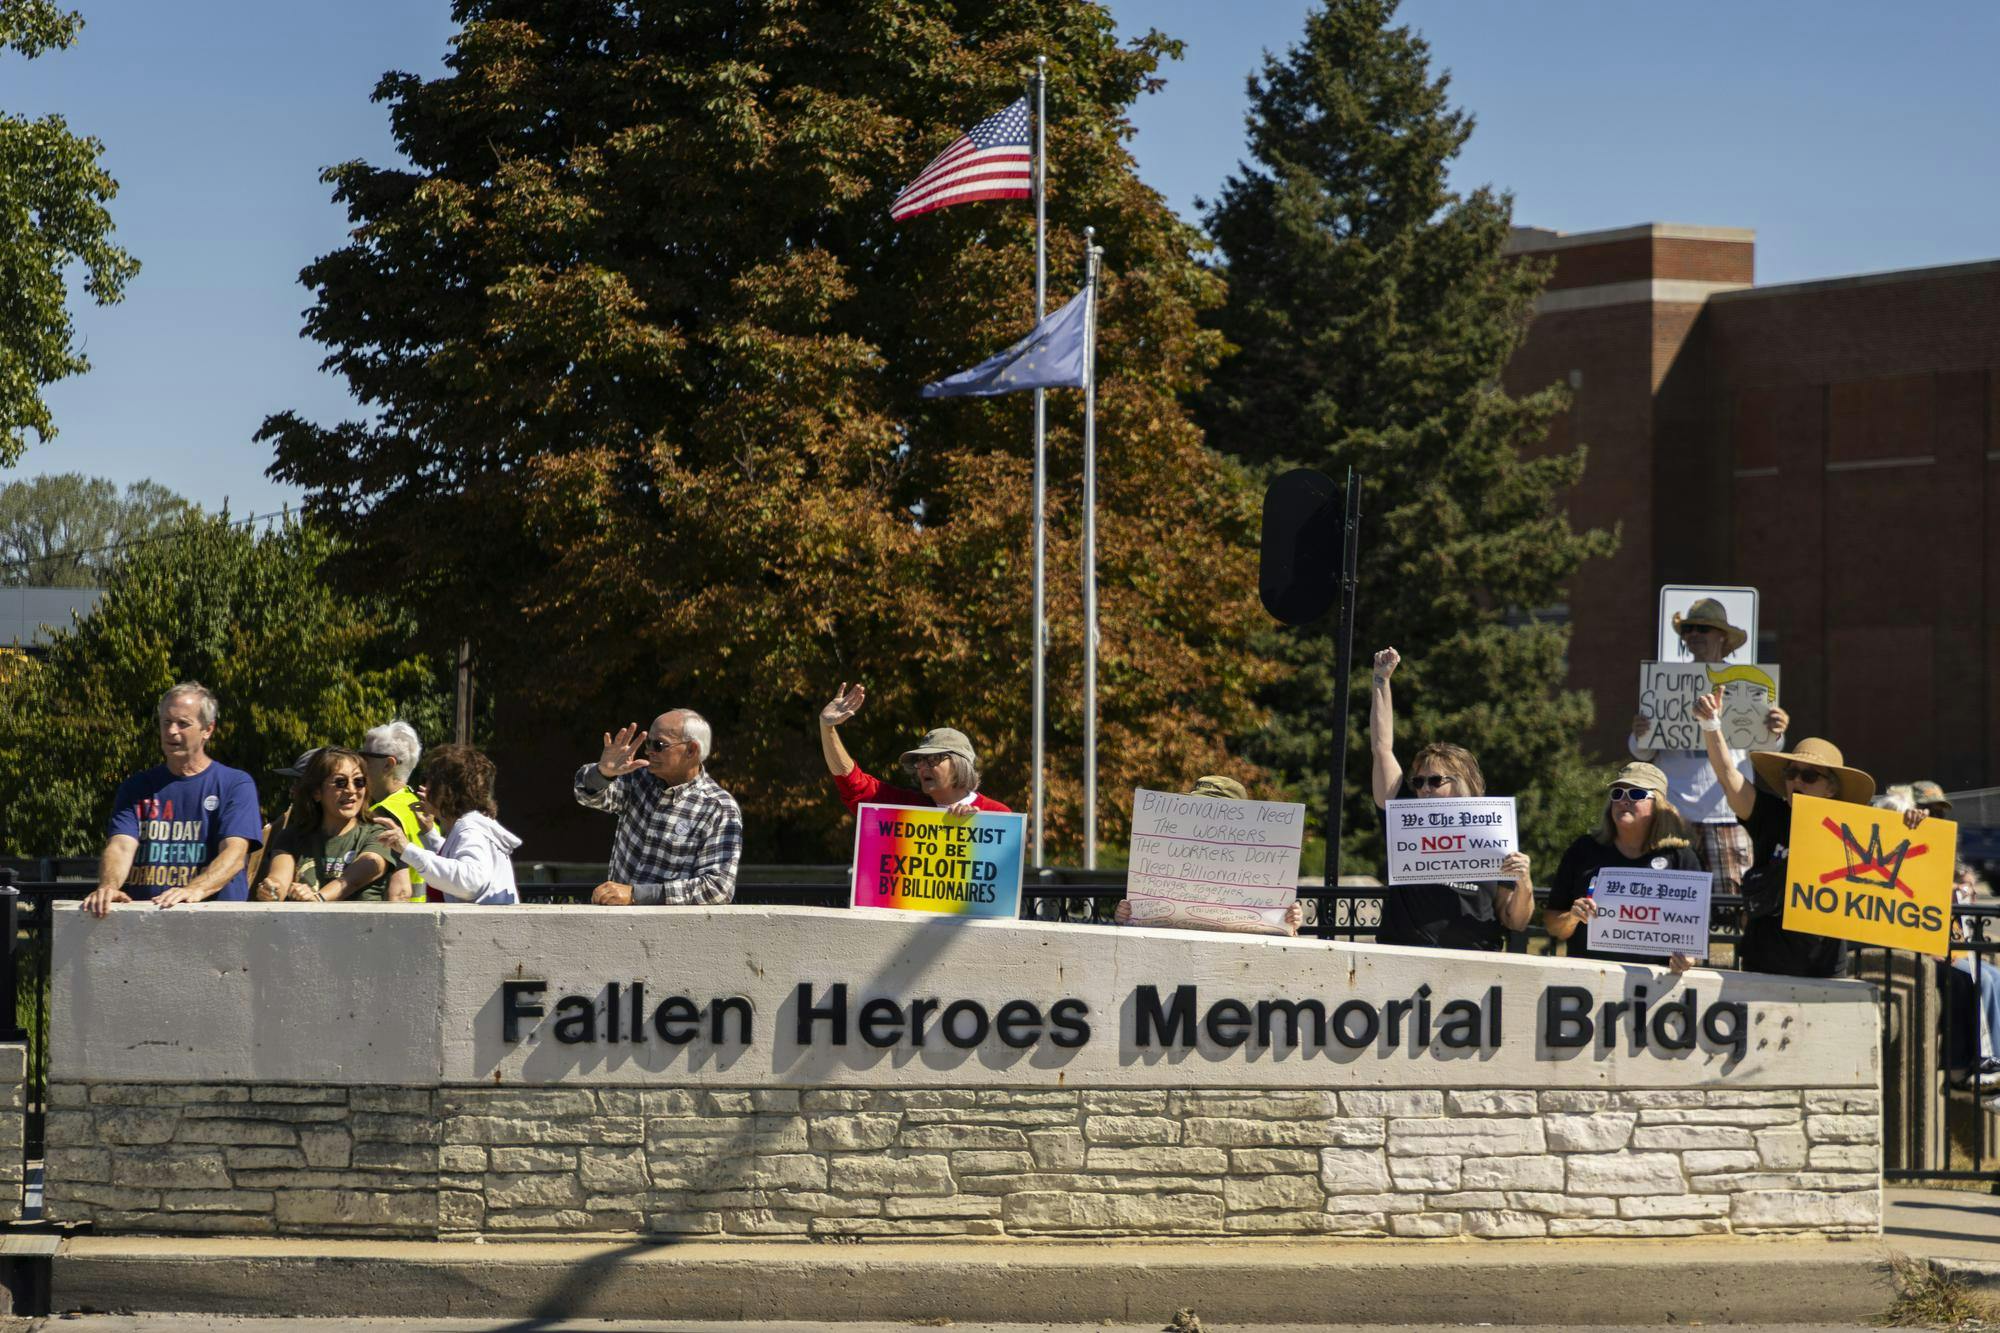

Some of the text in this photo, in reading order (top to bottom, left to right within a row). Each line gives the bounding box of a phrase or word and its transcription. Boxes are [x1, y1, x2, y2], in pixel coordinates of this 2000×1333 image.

[1641, 661, 1705, 699] Trump
[1641, 690, 1698, 722] Suck
[162, 800, 174, 820] A
[1401, 812, 1502, 827] We The People
[172, 821, 202, 840] DAY
[879, 821, 1006, 845] WE DON'T EXIST
[149, 842, 207, 864] DEFEND
[914, 841, 967, 857] TO BE
[1421, 835, 1466, 850] NOT
[880, 855, 997, 881] EXPLOITED
[879, 876, 996, 903] BY BILLIONAIRES
[1606, 881, 1697, 900] We The People
[1620, 905, 1661, 920] NOT
[1791, 883, 1943, 932] NO KINGS
[502, 980, 1747, 1061] Fallen Heroes Memorial Bridg
